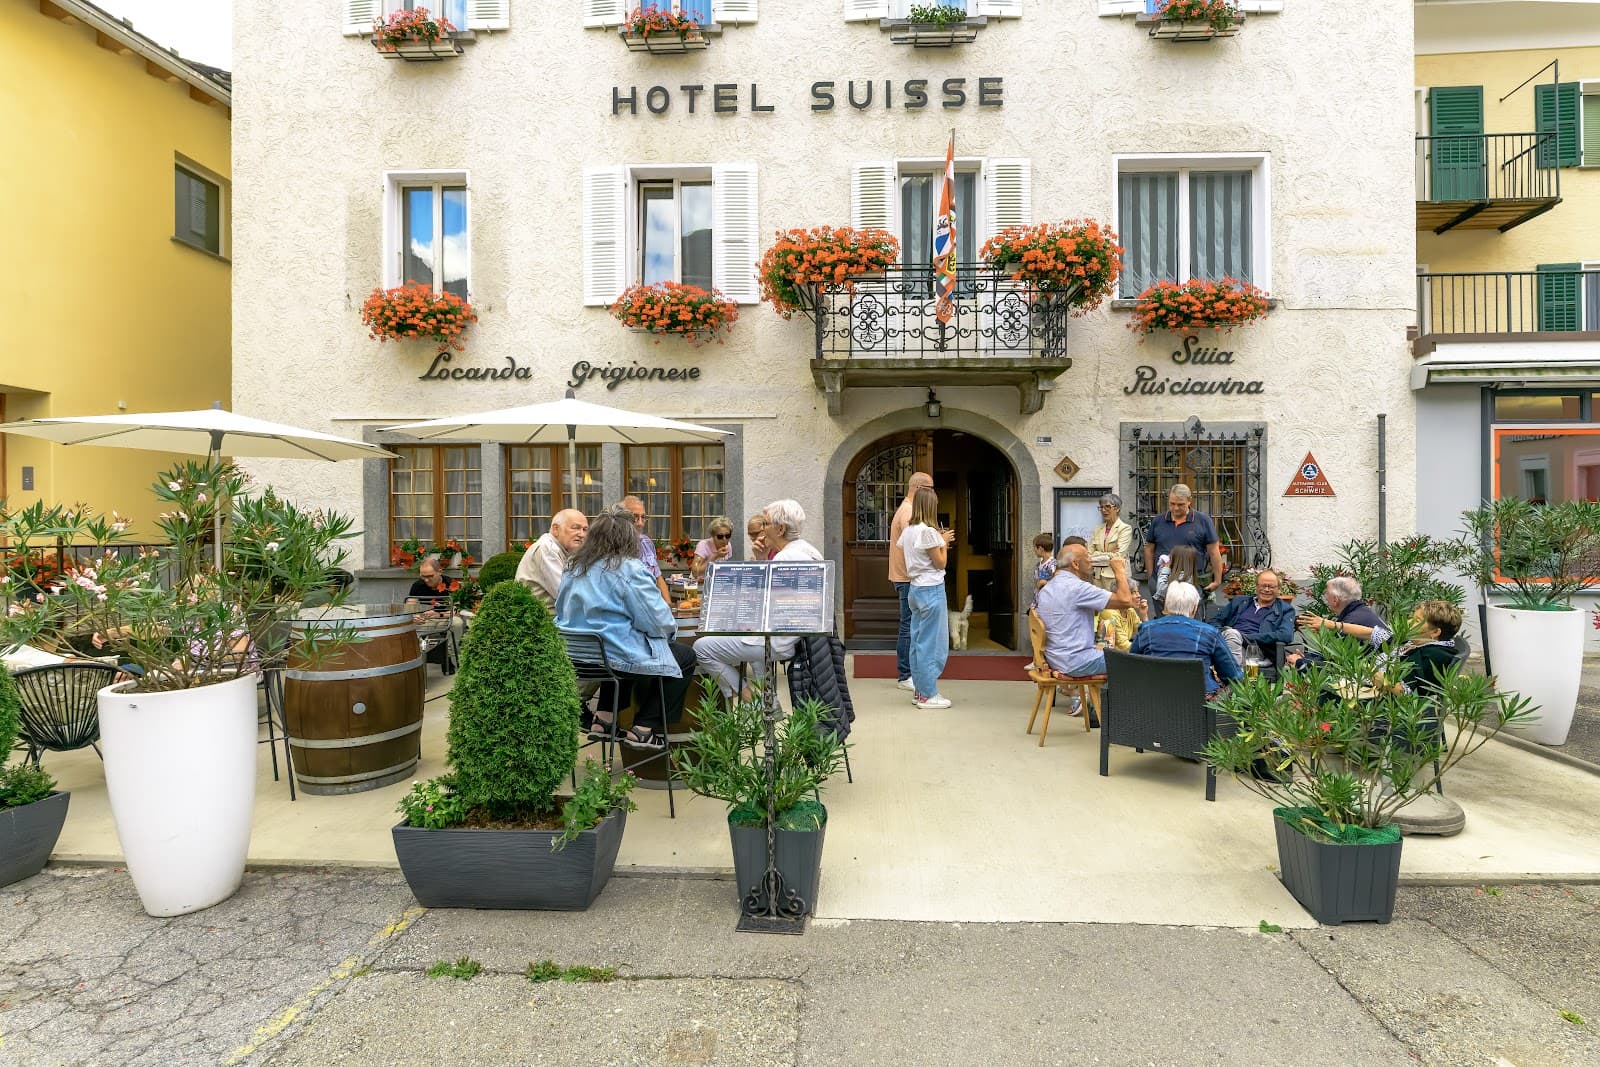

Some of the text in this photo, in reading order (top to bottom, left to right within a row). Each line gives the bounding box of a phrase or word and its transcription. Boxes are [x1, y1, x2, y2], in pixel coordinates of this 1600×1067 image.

[612, 77, 1004, 115] HOTEL SUISSE
[418, 352, 700, 390] Locanda Grigionese
